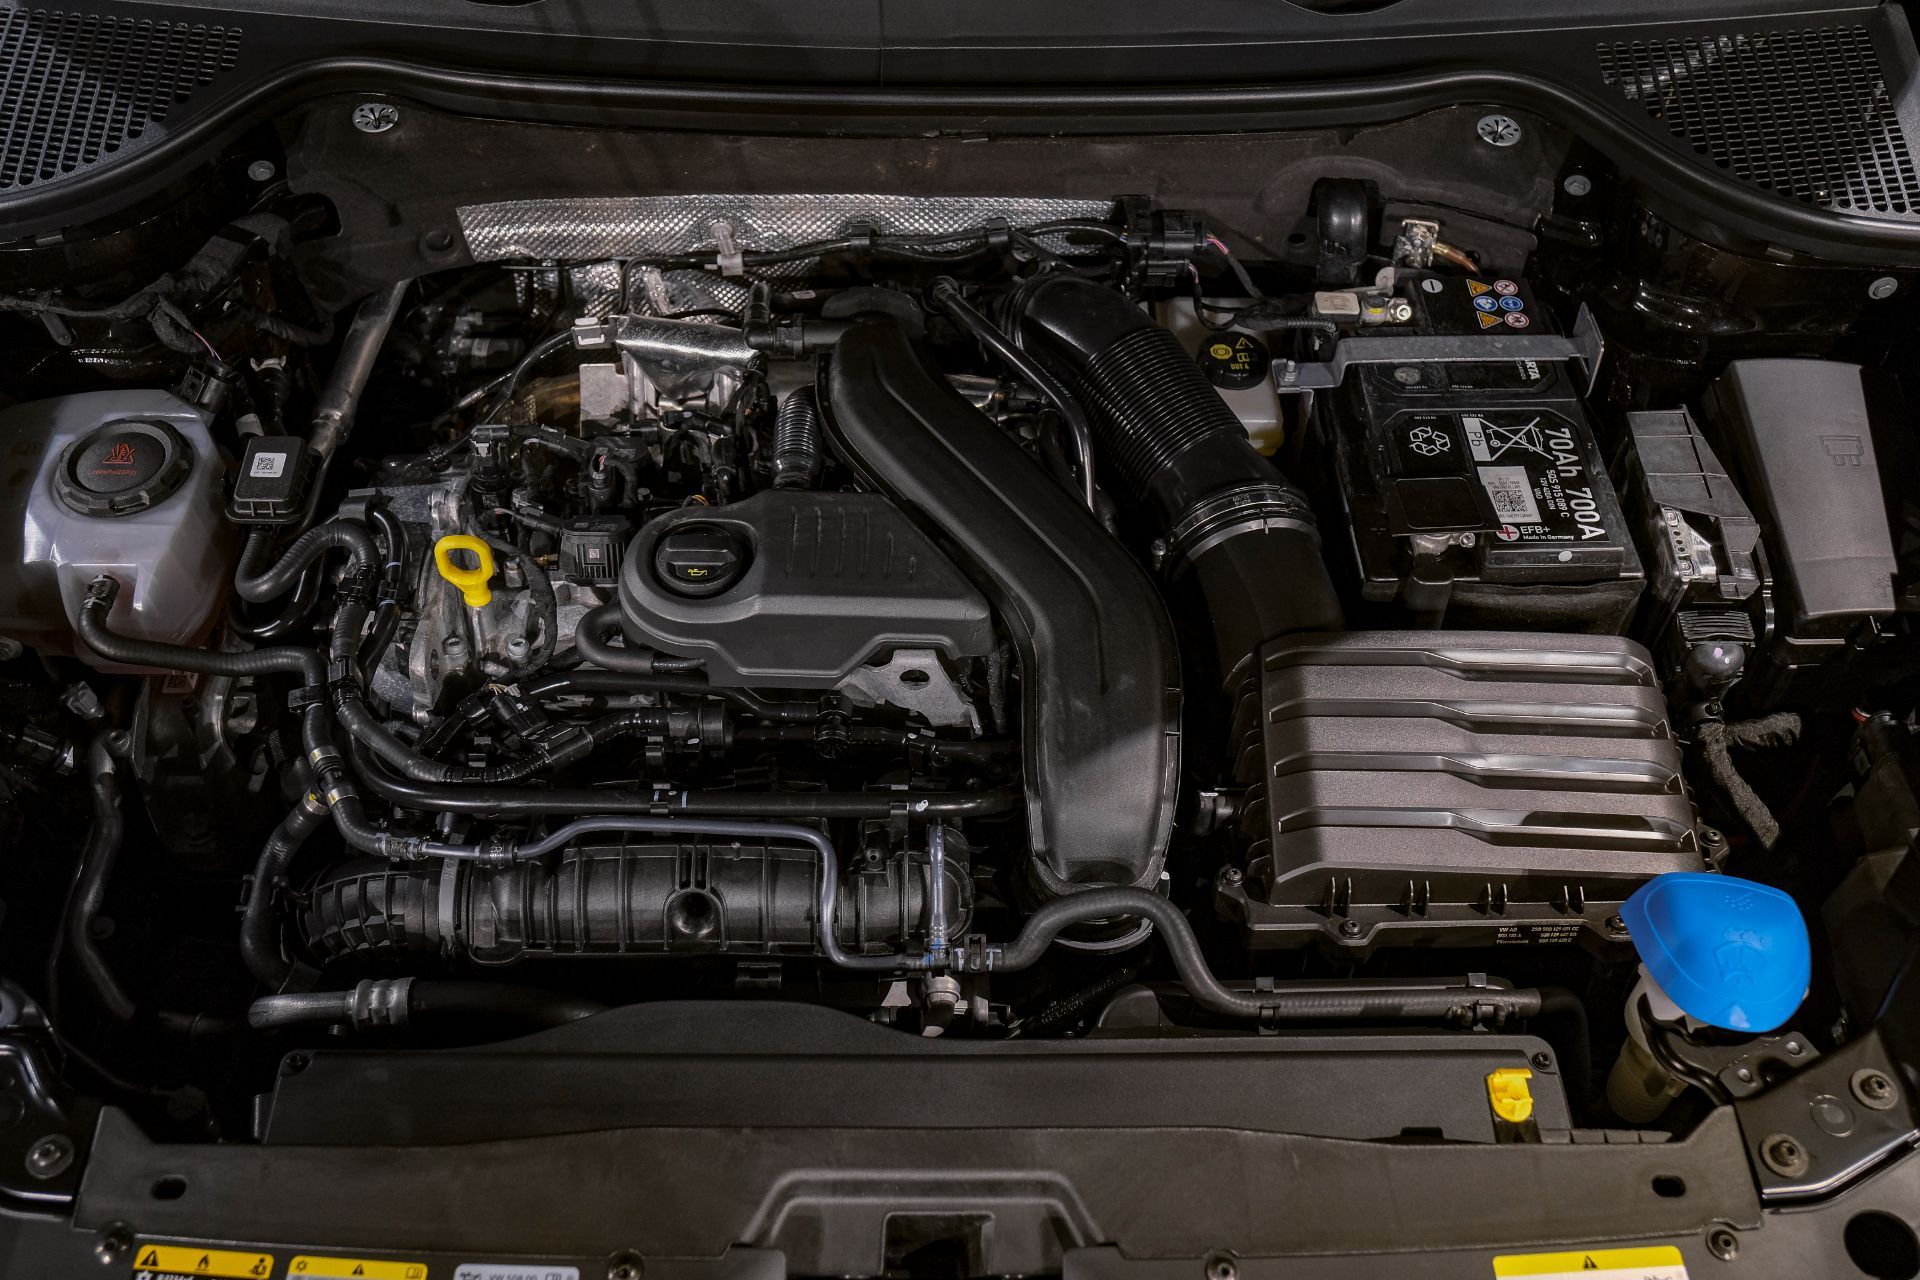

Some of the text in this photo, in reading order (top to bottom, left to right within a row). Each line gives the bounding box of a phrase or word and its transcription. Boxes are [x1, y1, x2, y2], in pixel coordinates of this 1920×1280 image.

[1468, 432, 1484, 446] Pb
[1545, 427, 1606, 540] 70Ah 700A
[1551, 484, 1564, 498] 915
[1520, 526, 1551, 534] EFB+
